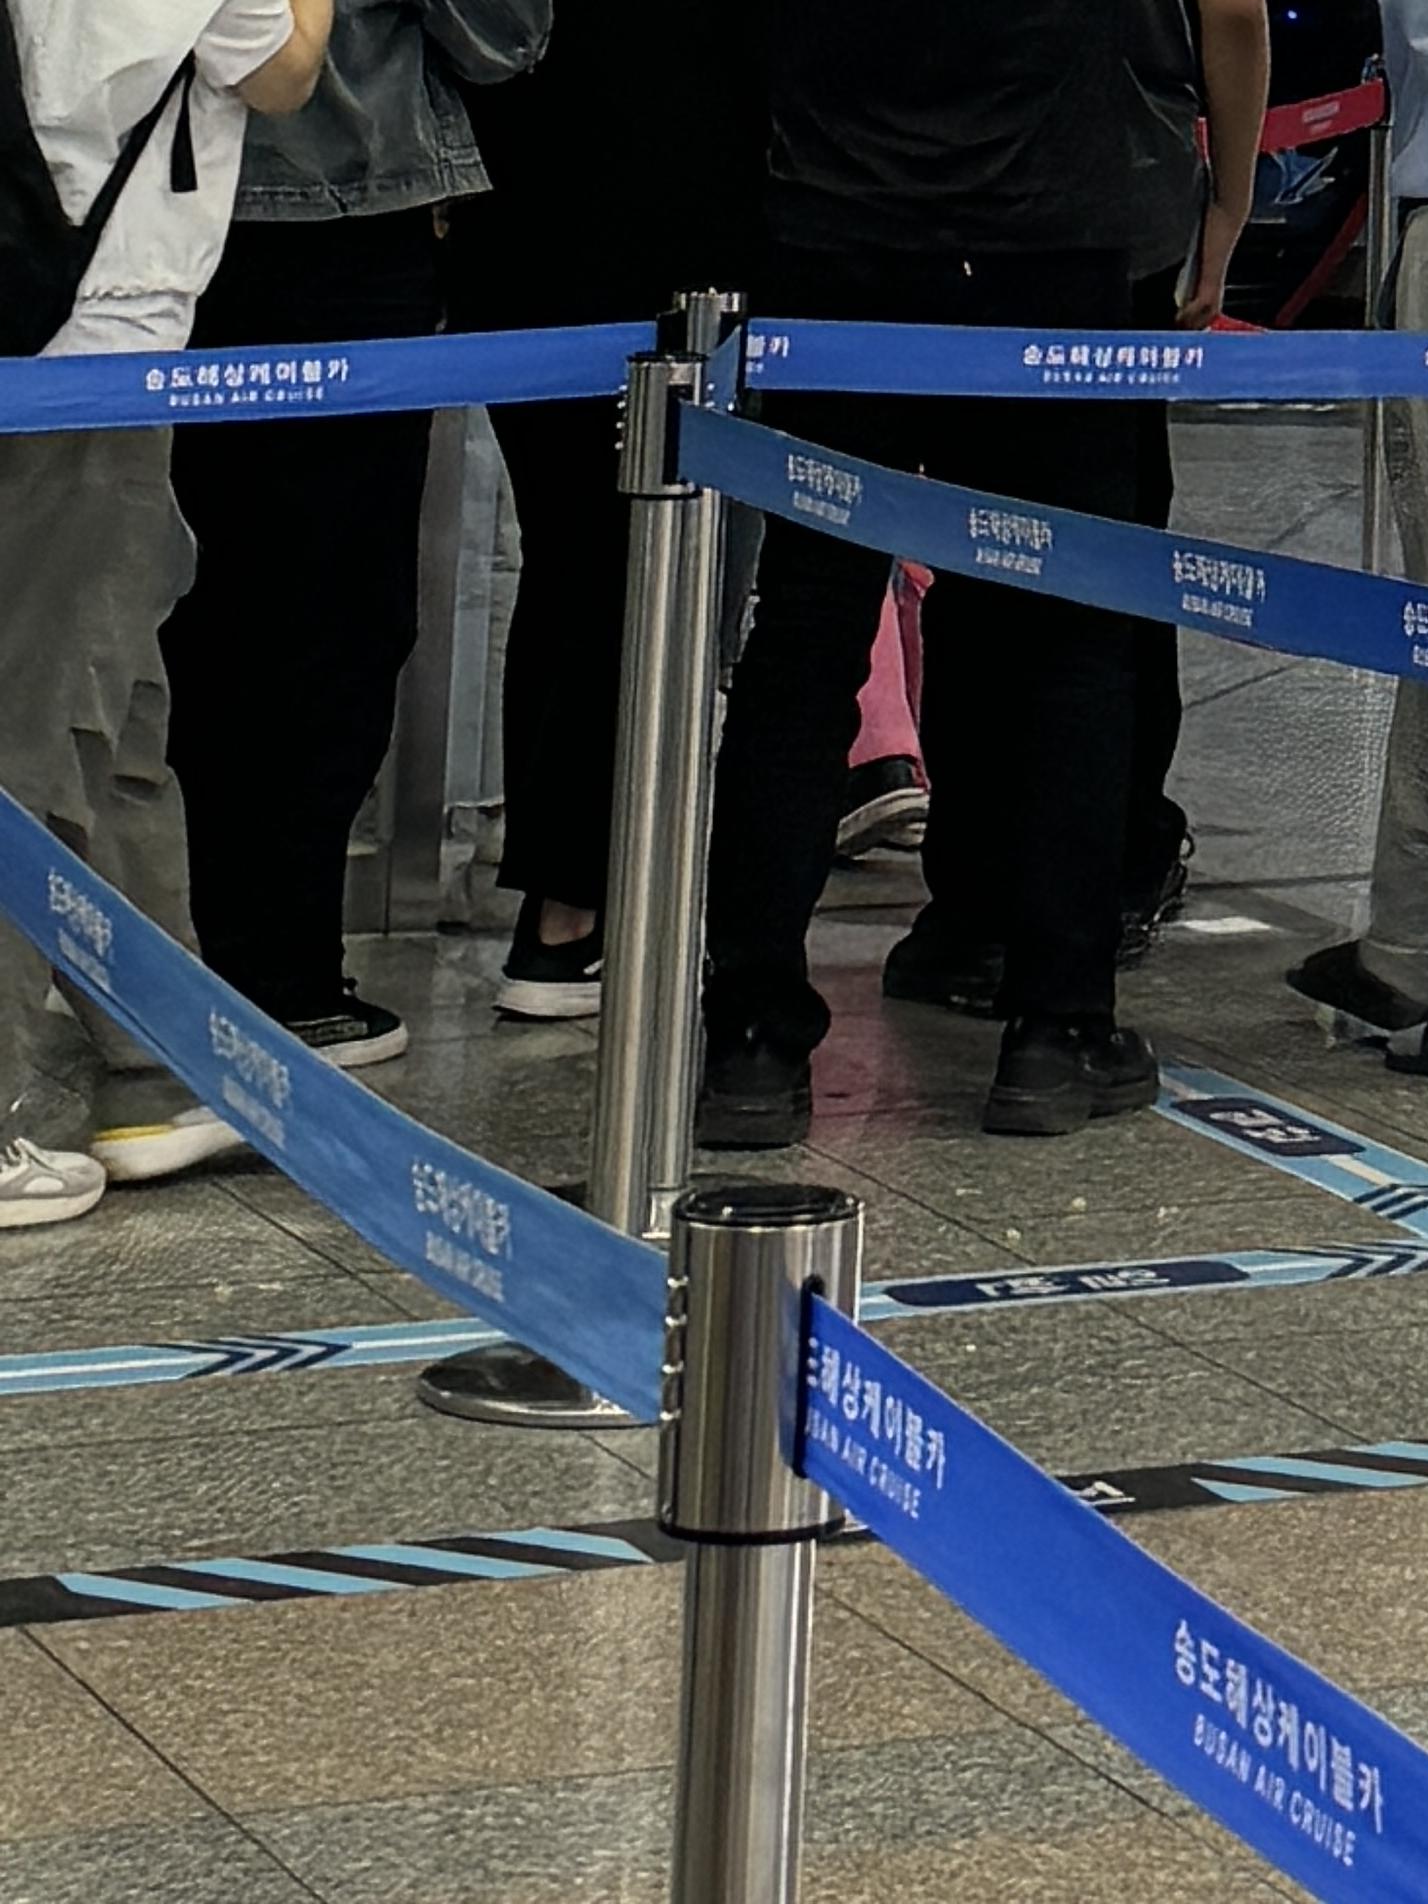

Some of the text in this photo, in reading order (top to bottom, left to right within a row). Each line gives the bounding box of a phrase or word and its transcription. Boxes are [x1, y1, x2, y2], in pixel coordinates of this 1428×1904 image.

[1175, 1619, 1383, 1834] 송도해상케이블카
[1194, 1714, 1356, 1867] BUSAN AIR CRUISE
